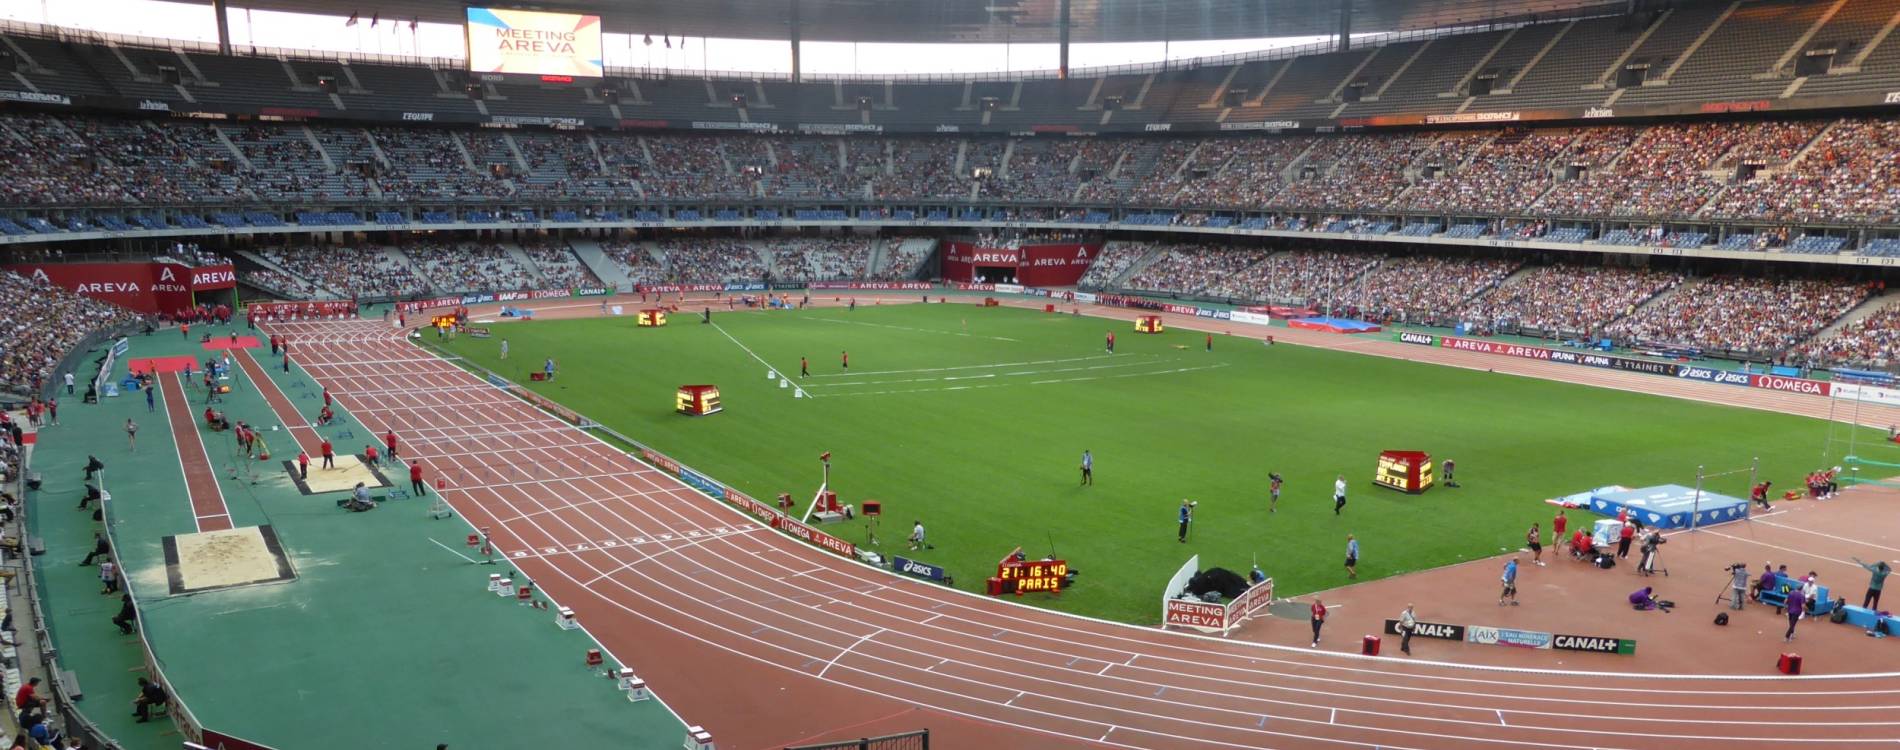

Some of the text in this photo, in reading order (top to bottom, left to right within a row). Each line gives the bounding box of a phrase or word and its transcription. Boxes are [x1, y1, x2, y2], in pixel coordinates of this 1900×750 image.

[497, 28, 576, 41] MEETING
[499, 40, 575, 54] AREVA
[974, 254, 1017, 263] AREVA
[1034, 258, 1066, 266] AREVA
[193, 272, 236, 285] AREVA
[77, 283, 140, 293] AREVA
[152, 284, 186, 292] AREVA
[543, 289, 570, 298] OMEGA
[436, 298, 460, 306] AREVA
[1172, 304, 1194, 314] AREVA
[1400, 332, 1432, 344] CANAL+
[1454, 340, 1548, 359] AREVA AREVA
[1773, 380, 1822, 394] OMEGA
[730, 494, 750, 508] AREVA
[788, 522, 810, 540] OMEGA
[823, 538, 852, 554] AREVA
[1018, 578, 1058, 590] PARIS
[1169, 602, 1223, 616] MEETING
[1171, 613, 1220, 626] AREVA
[1394, 622, 1454, 637] CNAL+
[1555, 636, 1616, 650] CANAL+
